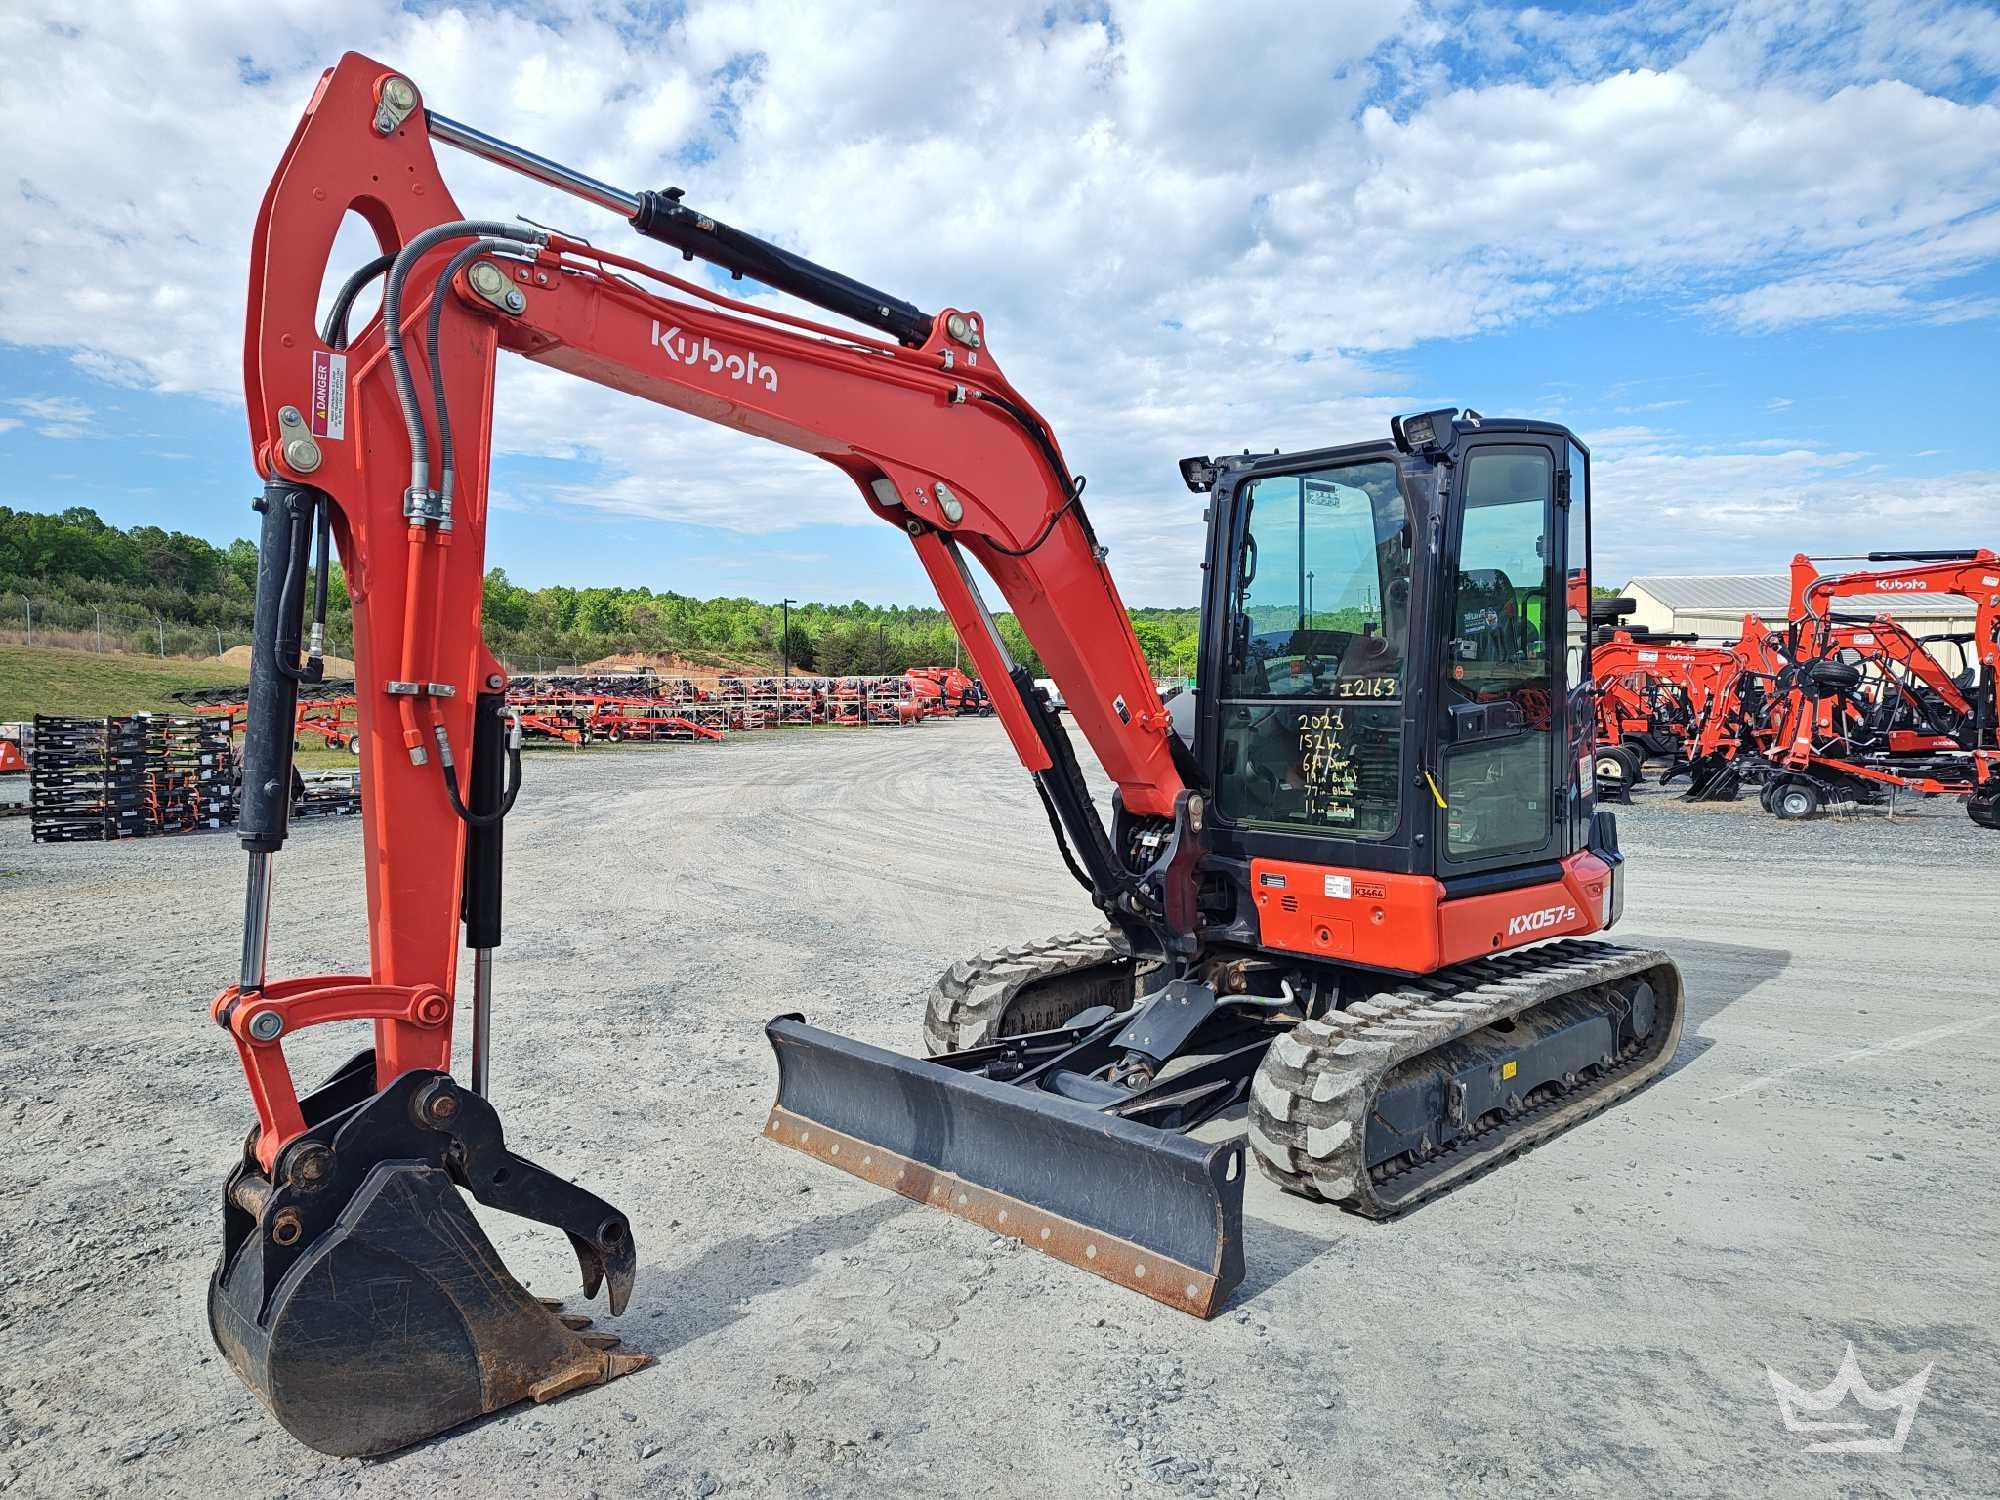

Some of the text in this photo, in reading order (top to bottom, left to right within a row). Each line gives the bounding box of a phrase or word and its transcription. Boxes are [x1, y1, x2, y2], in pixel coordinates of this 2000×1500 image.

[651, 319, 778, 392] Kubota
[316, 365, 328, 410] DANGER
[1875, 579, 1927, 590] Kubota
[1665, 652, 1696, 661] Kubota
[1340, 678, 1395, 697] I2163
[1298, 714, 1344, 730] 2023
